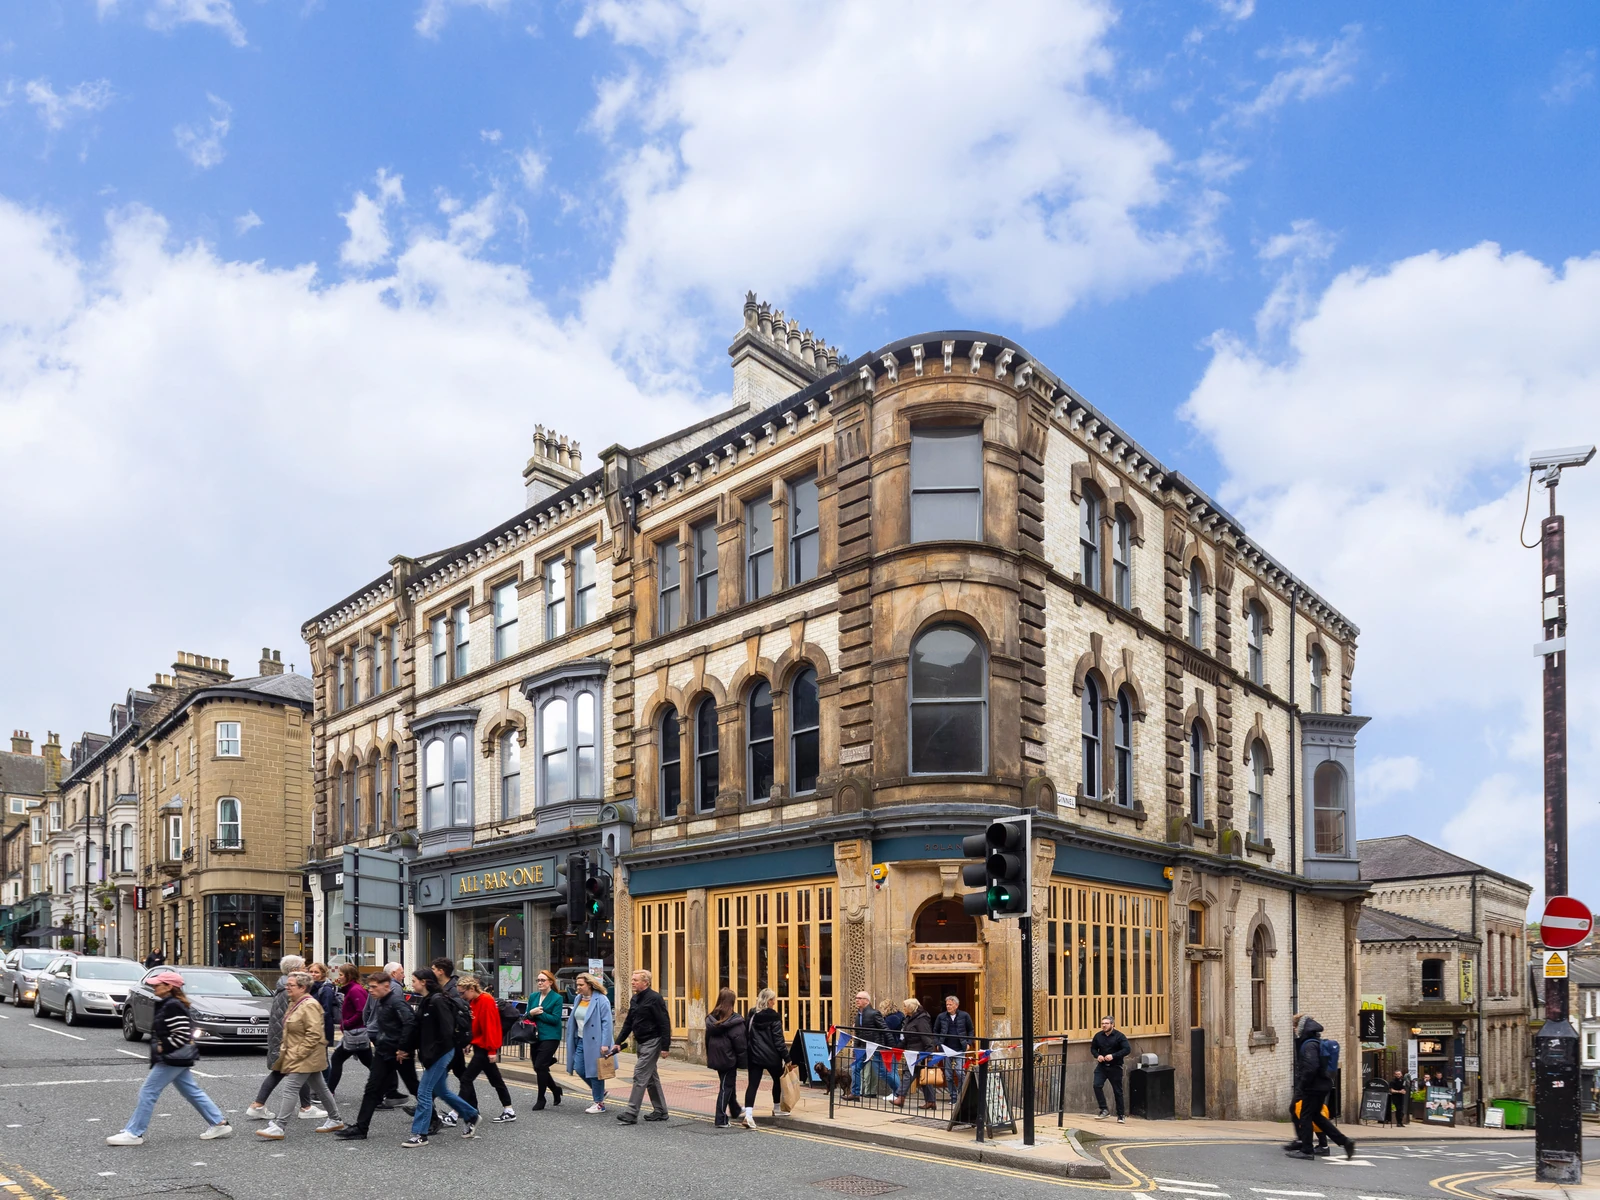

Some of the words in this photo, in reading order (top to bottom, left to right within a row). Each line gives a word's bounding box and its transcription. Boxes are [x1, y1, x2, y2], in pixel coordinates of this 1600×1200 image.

[1058, 795, 1075, 807] GINNEL
[924, 843, 963, 851] ROLAN
[459, 876, 480, 894] ALL
[484, 870, 510, 891] BAR
[513, 865, 544, 887] ONE
[499, 926, 507, 936] H
[920, 953, 972, 961] ROLAND'S
